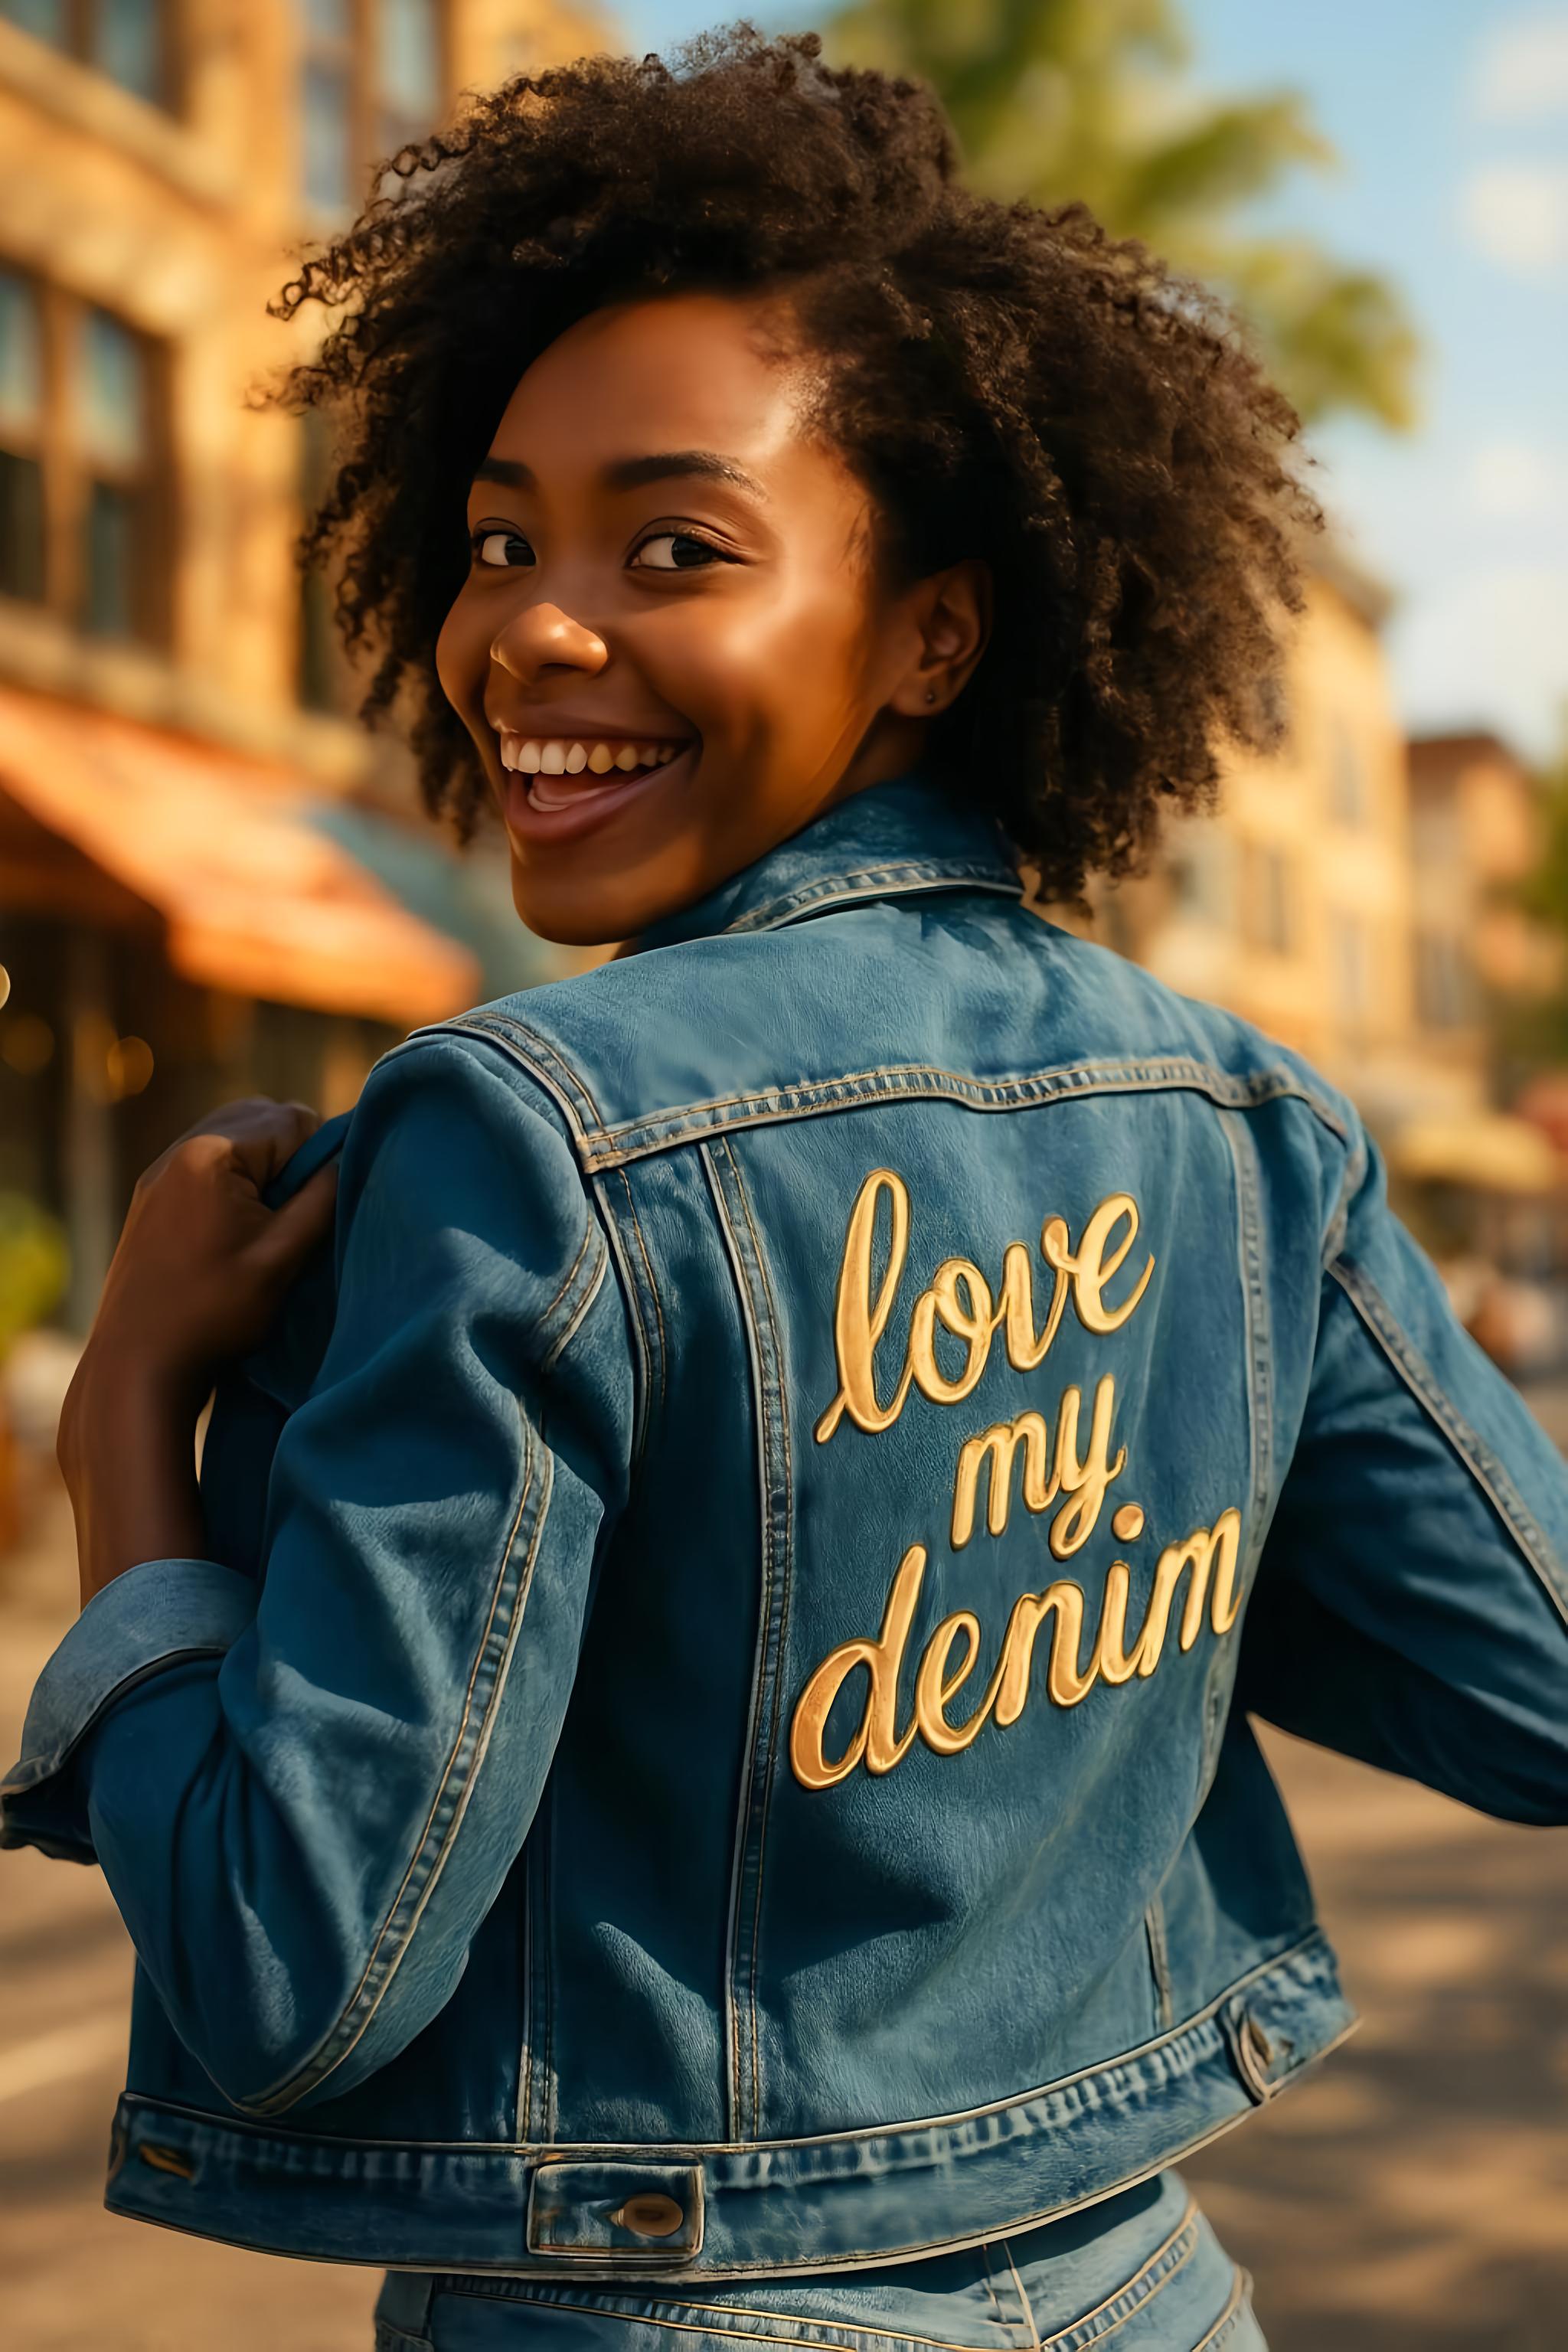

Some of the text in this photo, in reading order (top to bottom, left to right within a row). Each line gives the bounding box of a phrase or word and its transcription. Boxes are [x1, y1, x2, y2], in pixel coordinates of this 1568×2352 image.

[815, 1167, 1155, 1443] love
[951, 1373, 1127, 1560] my
[790, 1502, 1244, 1790] denim
